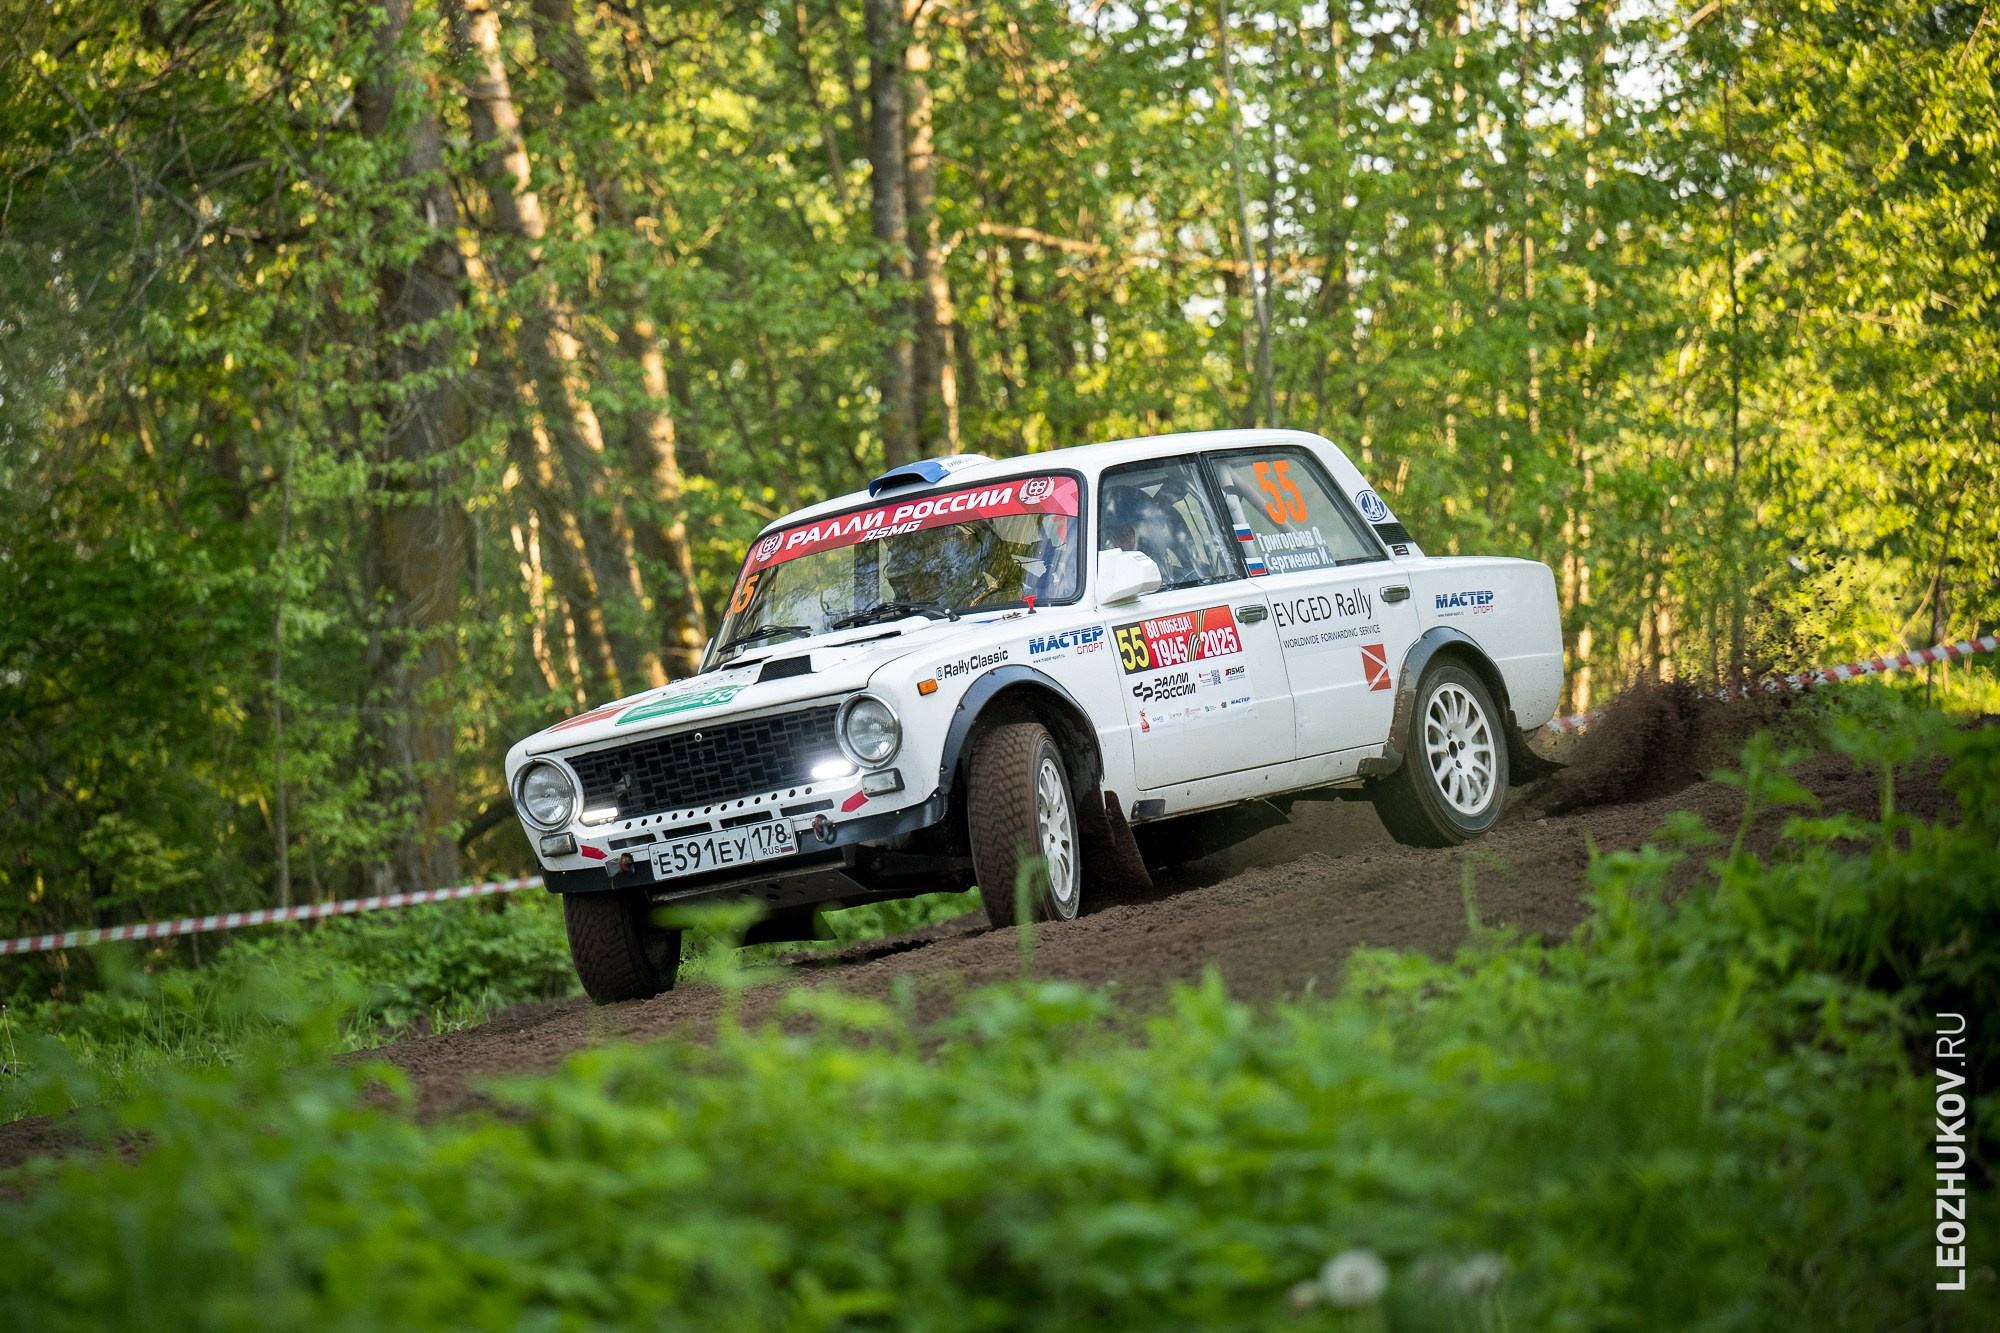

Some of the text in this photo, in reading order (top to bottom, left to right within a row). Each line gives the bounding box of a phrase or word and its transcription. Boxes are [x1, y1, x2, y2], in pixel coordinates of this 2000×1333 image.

[1253, 461, 1307, 525] 55
[785, 487, 1014, 551] РАЛЛИ РОССИИ
[1255, 526, 1326, 553] Григорьев О.
[1264, 546, 1333, 574] Сергиенко И.
[1274, 588, 1373, 628] EVGED Rally
[1435, 590, 1494, 609] МАСТЕР
[1473, 605, 1494, 615] СПОРТ
[1029, 625, 1104, 655] МАСТЕР
[1144, 615, 1193, 639] 80 ПОБЕДА!
[1282, 624, 1380, 649] WORLDWIDE FORWARDING SERVICE
[1077, 641, 1104, 655] СПОРТ
[1115, 626, 1150, 670] 55
[1151, 626, 1238, 667] 1945 2025
[1154, 672, 1189, 690] РАЛЛИ
[1154, 682, 1196, 702] РОССИИ
[751, 823, 787, 850] 178
[658, 837, 746, 875] Е591ЕУ
[762, 845, 780, 856] RUS
